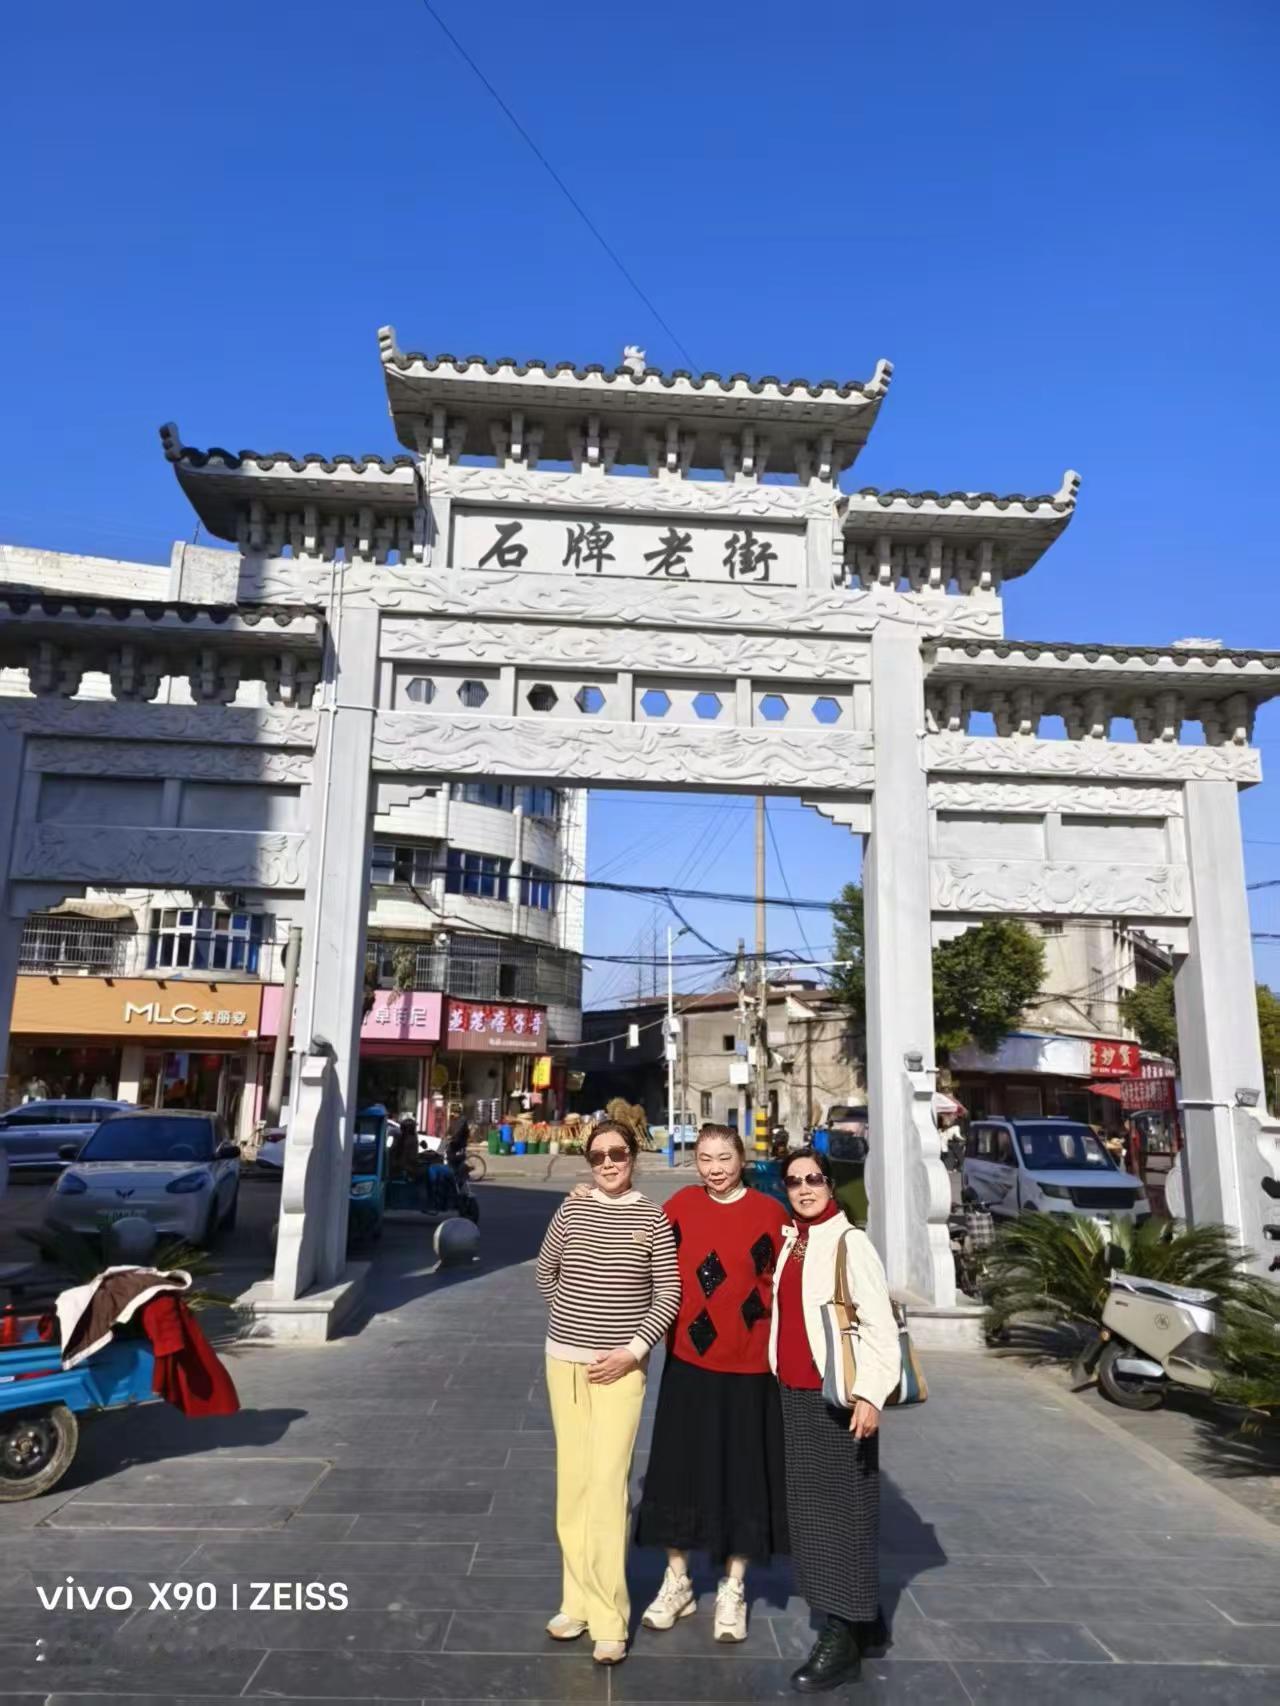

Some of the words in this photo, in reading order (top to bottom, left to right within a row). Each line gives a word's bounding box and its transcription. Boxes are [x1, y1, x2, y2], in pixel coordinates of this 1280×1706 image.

[478, 521, 778, 581] 石牌老街
[124, 1001, 199, 1024] MLC
